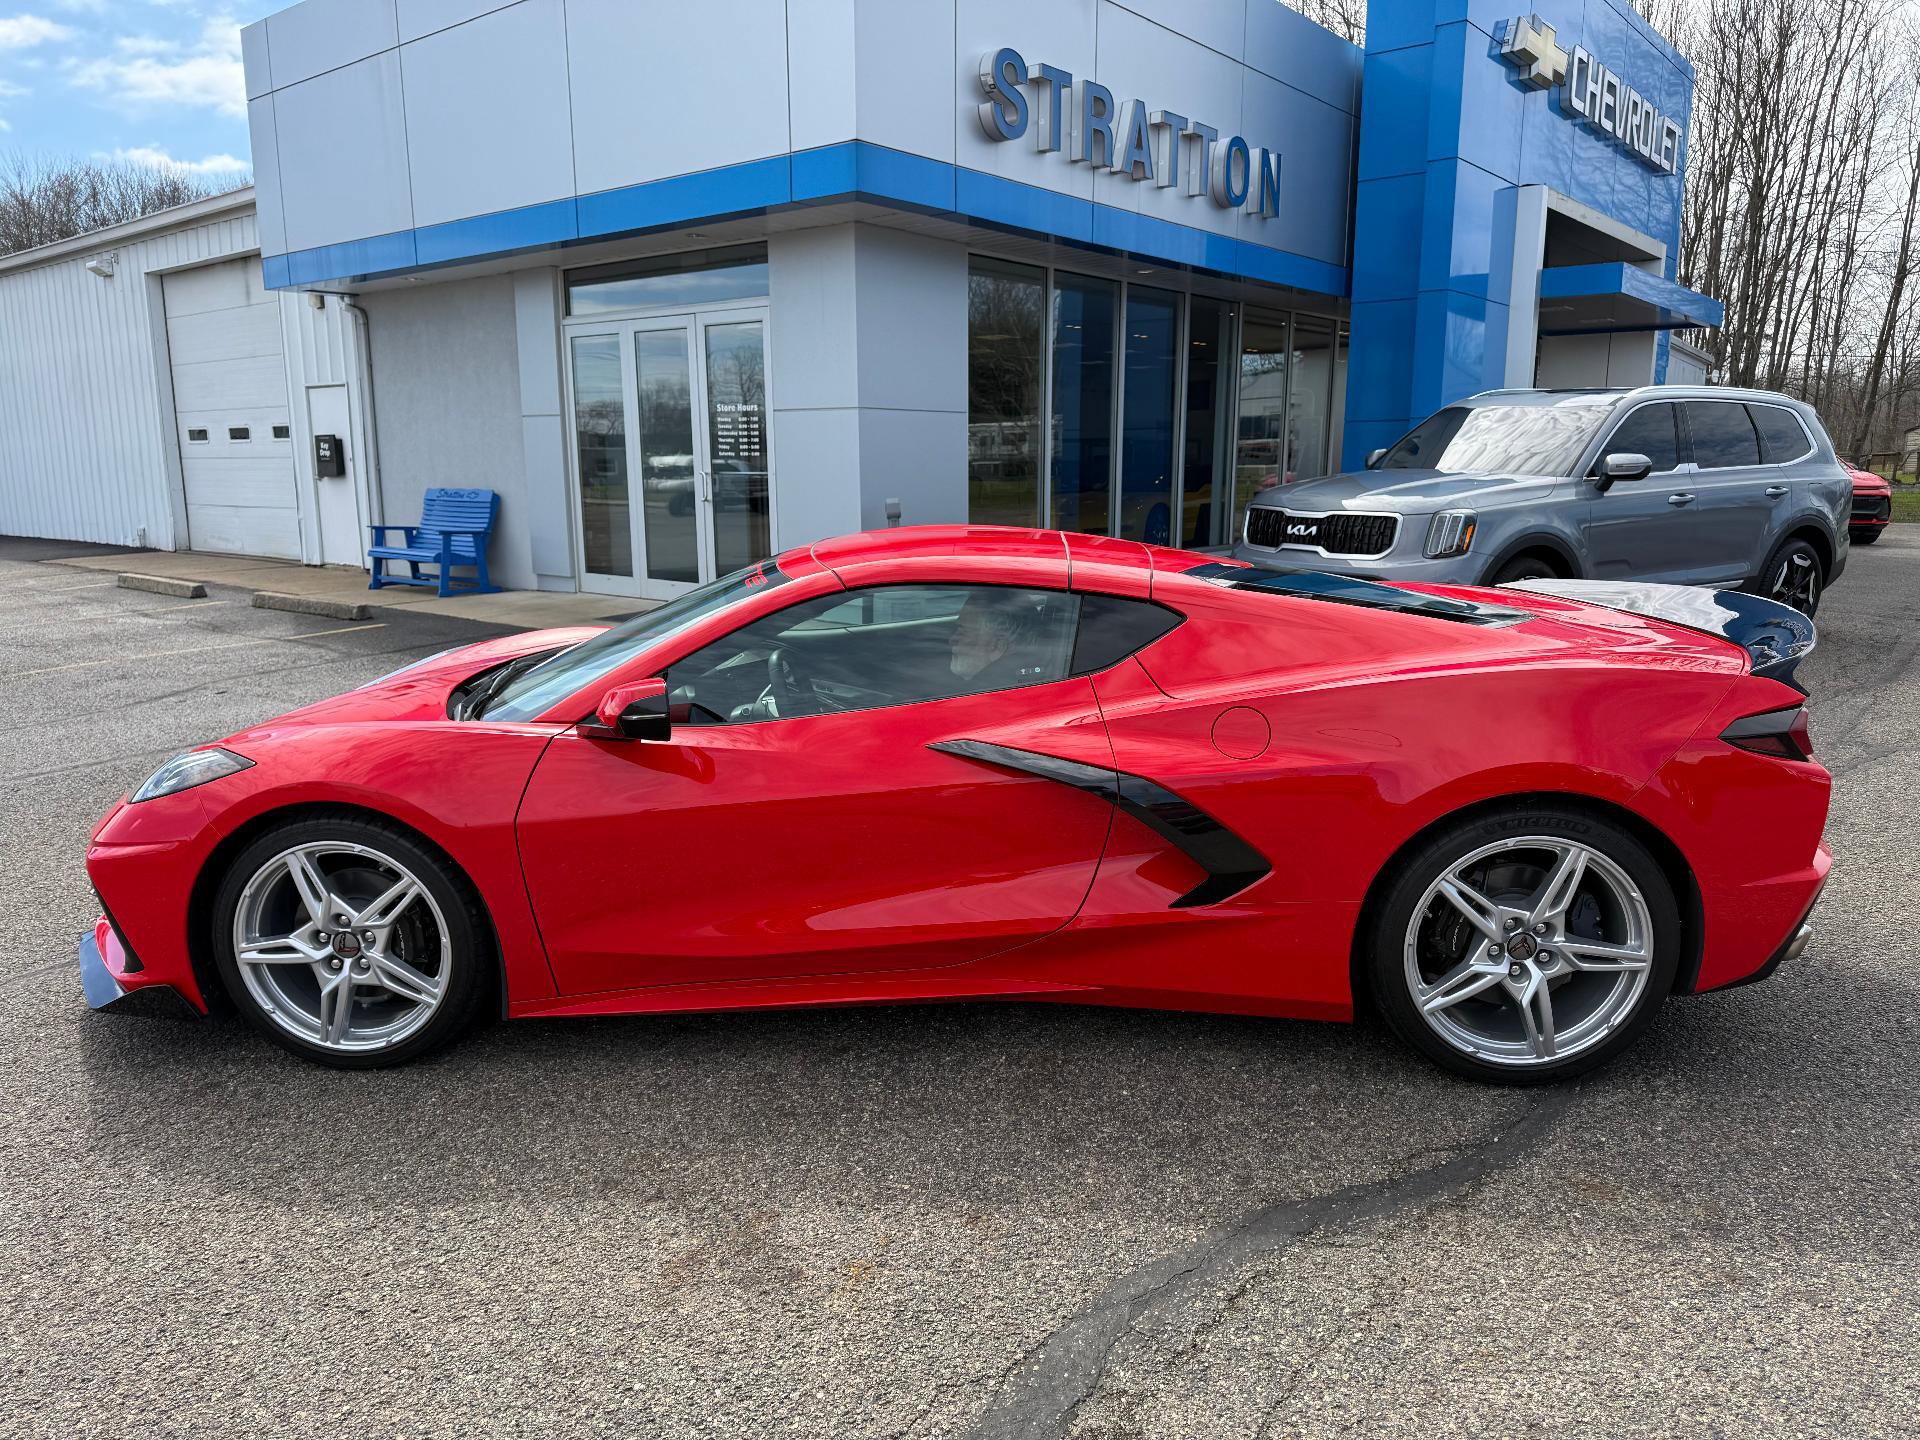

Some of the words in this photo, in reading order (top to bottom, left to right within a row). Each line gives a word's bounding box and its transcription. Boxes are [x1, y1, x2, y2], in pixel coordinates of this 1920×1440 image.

[1562, 44, 1683, 176] CHEVROLET
[979, 47, 1282, 219] STRATTON
[737, 403, 758, 411] Hours
[1286, 524, 1317, 537] KIA
[1506, 817, 1591, 834] MICHELIN
